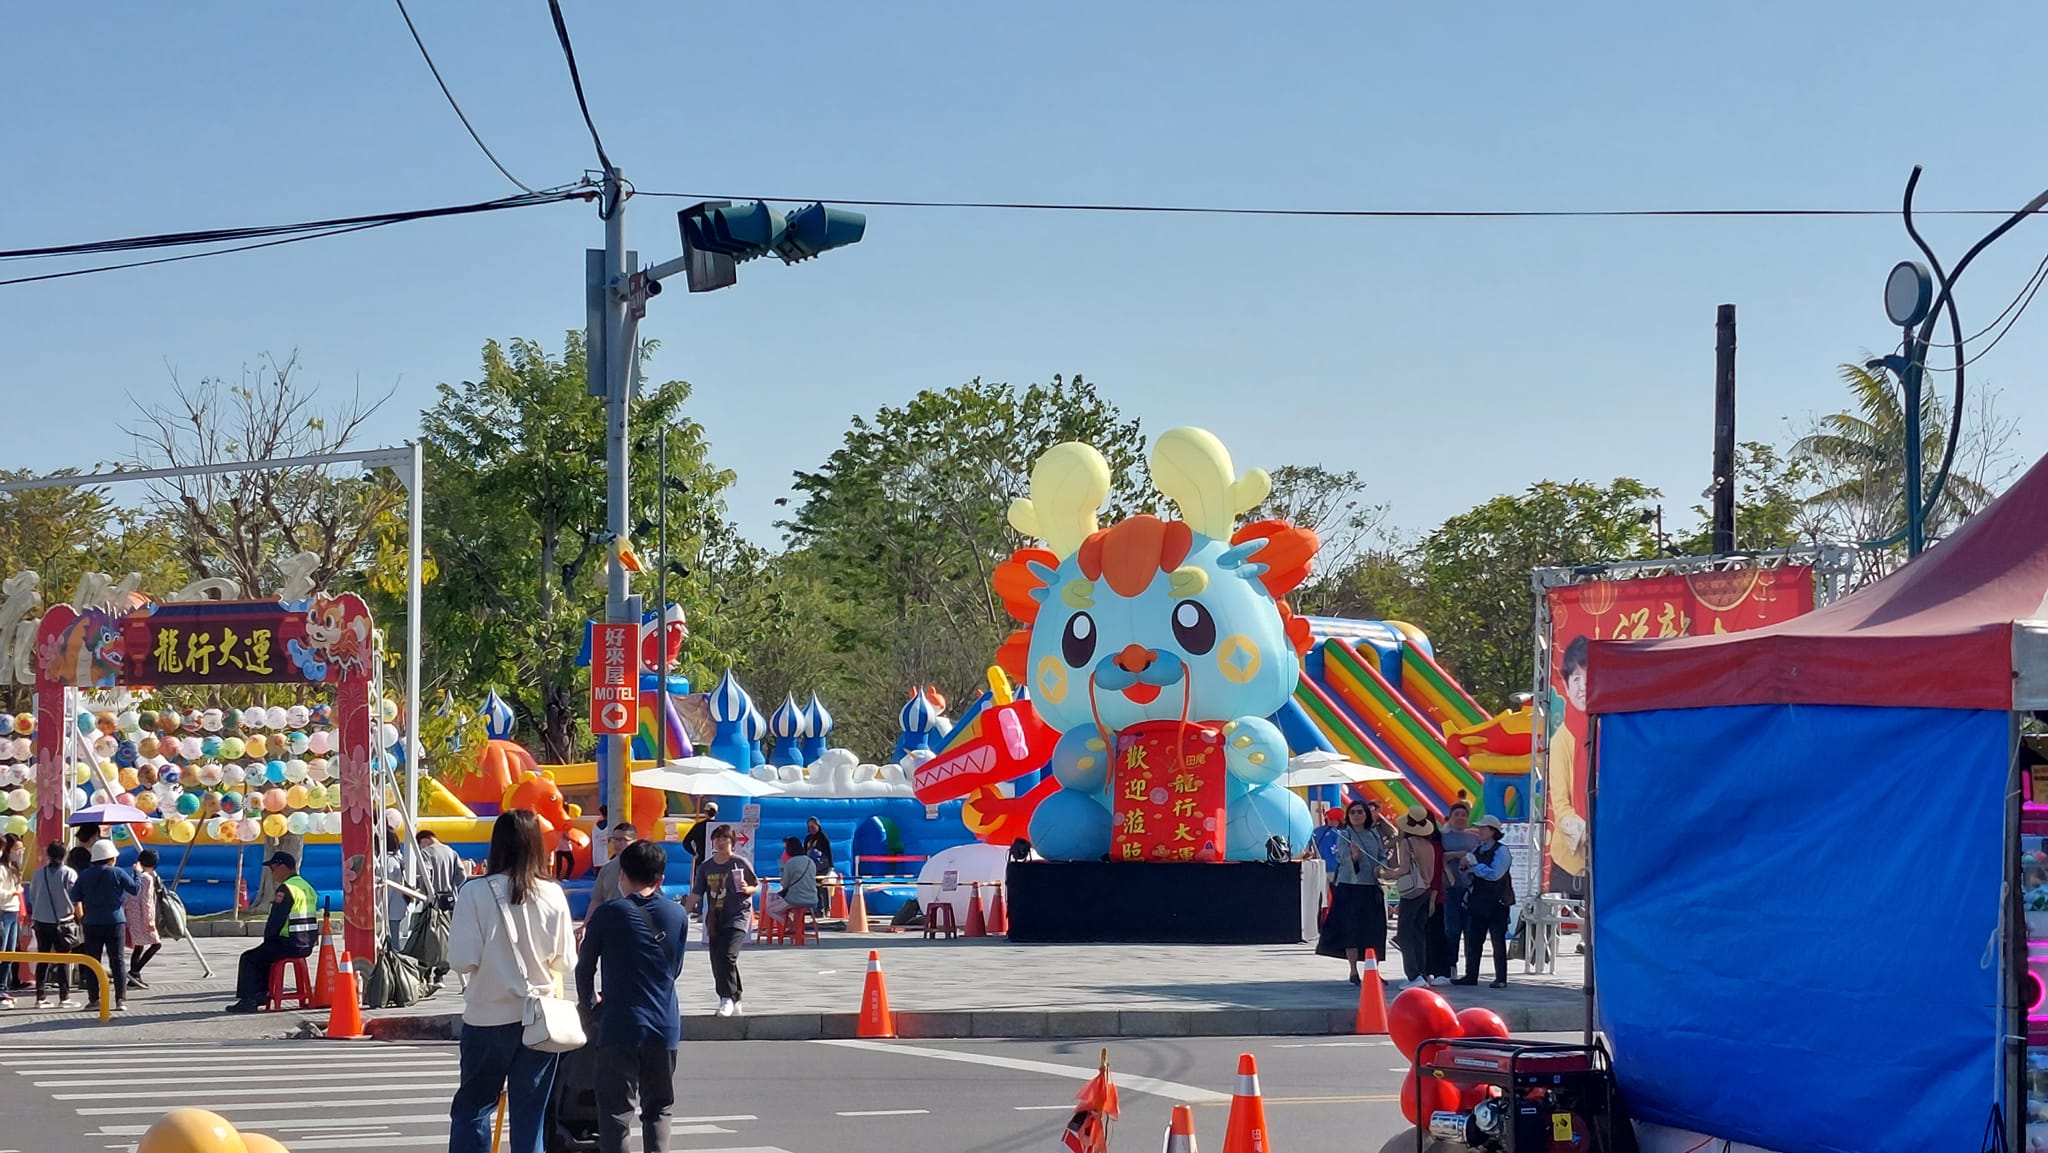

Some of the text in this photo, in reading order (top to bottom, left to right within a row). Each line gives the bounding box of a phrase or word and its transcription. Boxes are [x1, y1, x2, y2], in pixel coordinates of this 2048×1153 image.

[154, 627, 273, 675] 龍行大運
[605, 628, 625, 685] 好來屋
[594, 687, 635, 701] MOTEL
[1122, 745, 1150, 862] 歡迎蒞臨
[1171, 773, 1198, 862] 龍行大運
